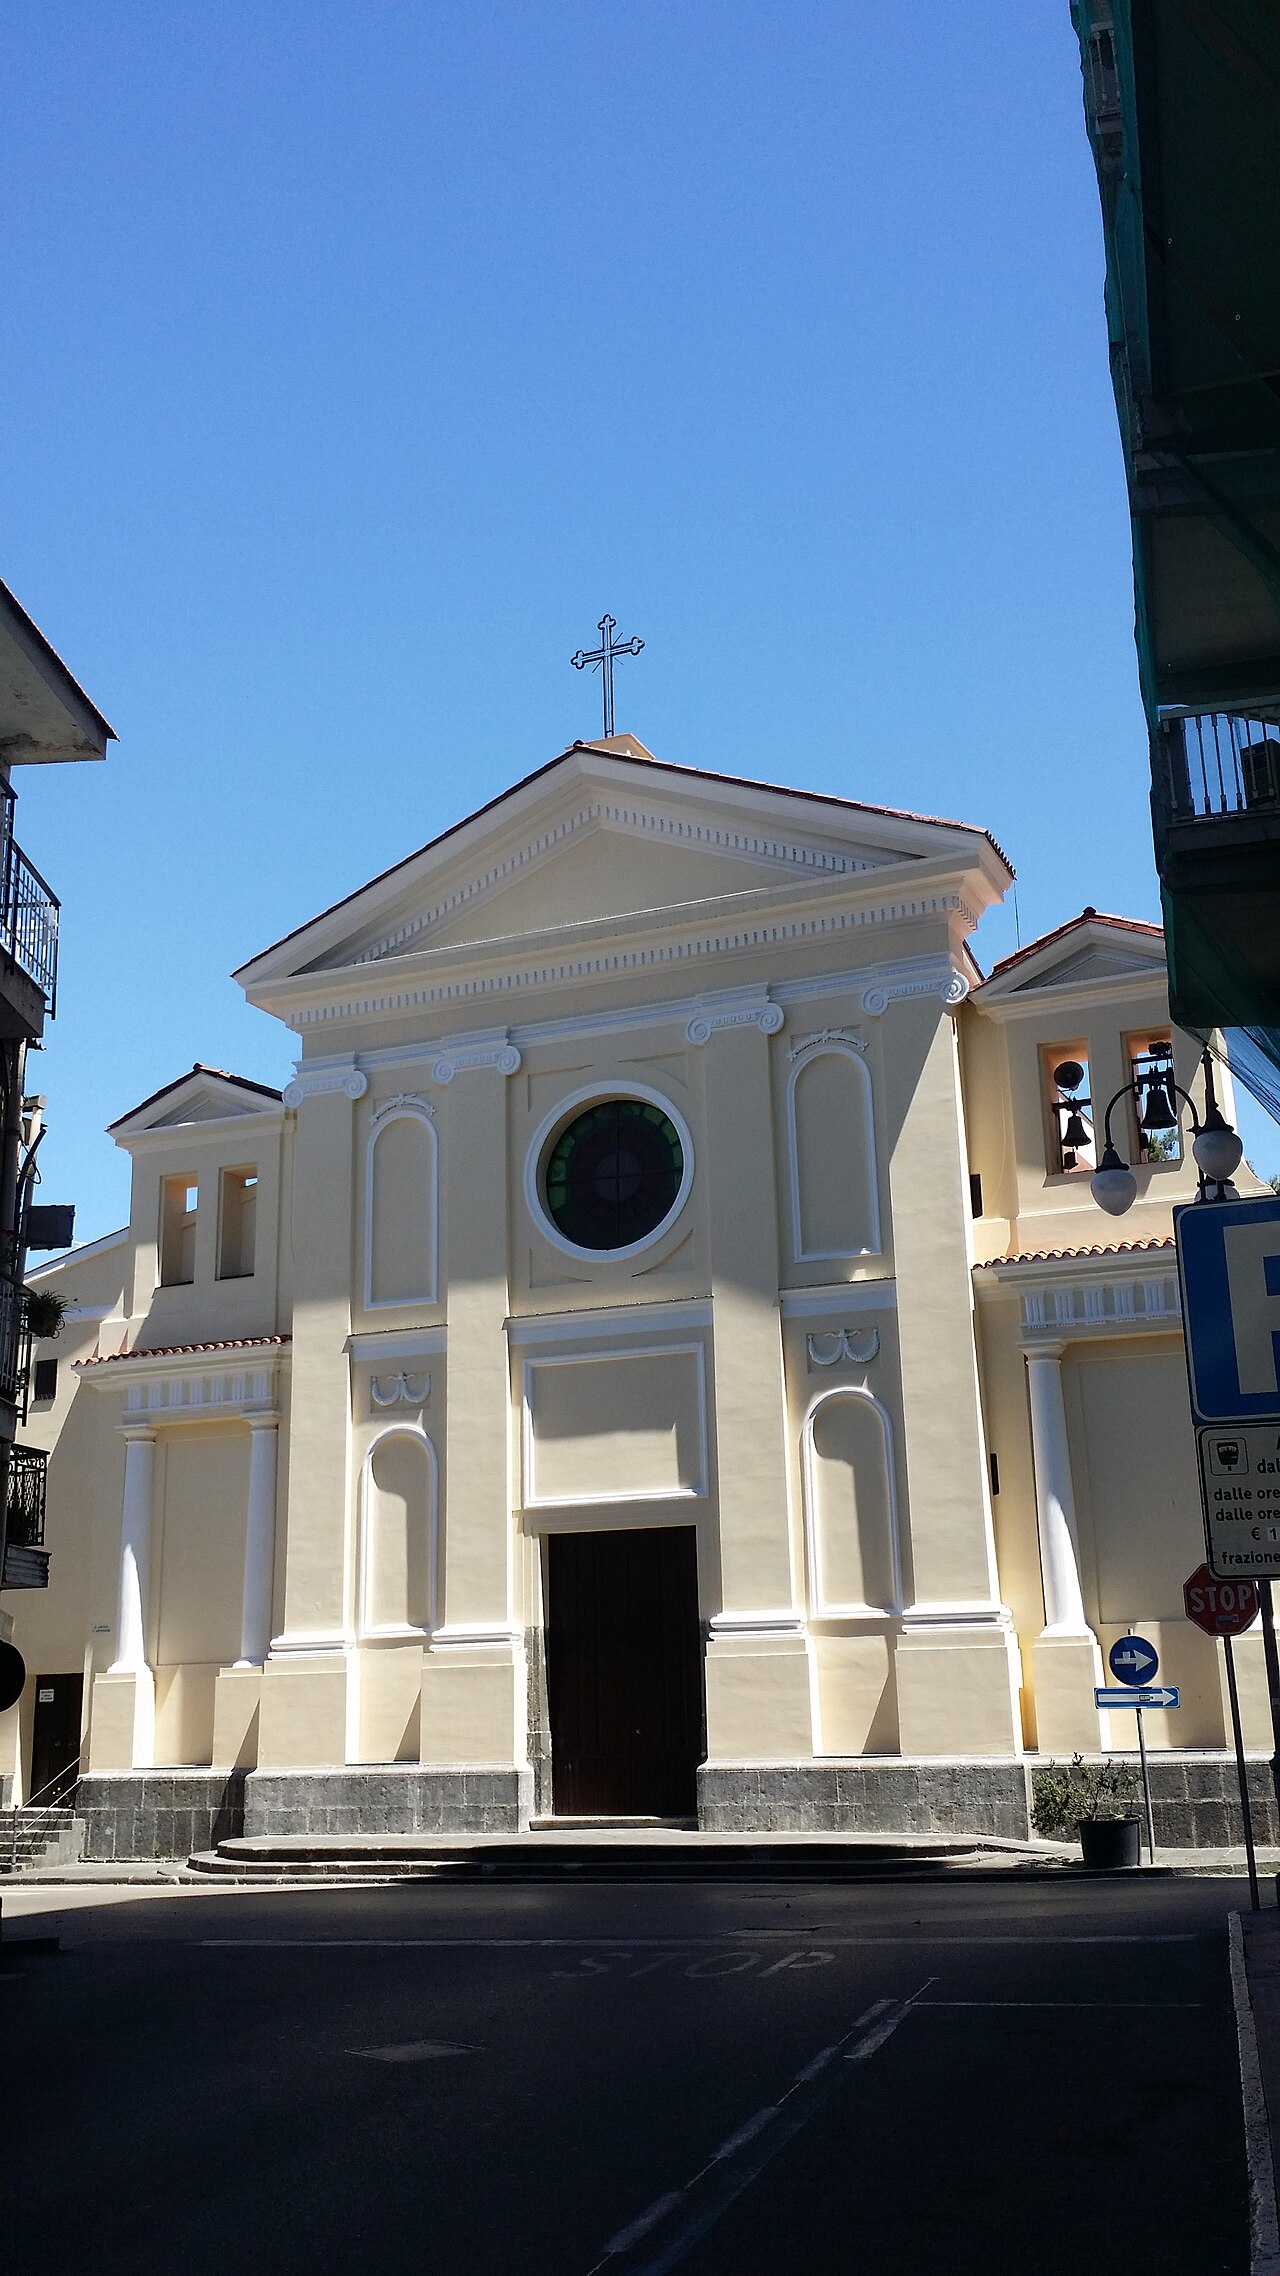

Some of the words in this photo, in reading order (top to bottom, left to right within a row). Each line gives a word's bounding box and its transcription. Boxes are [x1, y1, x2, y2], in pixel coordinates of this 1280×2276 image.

[1214, 1487, 1252, 1501] dalle
[1256, 1488, 1280, 1500] ore
[1216, 1508, 1253, 1521] dalle
[1257, 1508, 1280, 1520] ore
[1221, 1551, 1280, 1565] frazione
[1190, 1585, 1252, 1613] STOP
[550, 1951, 837, 1980] STOP
